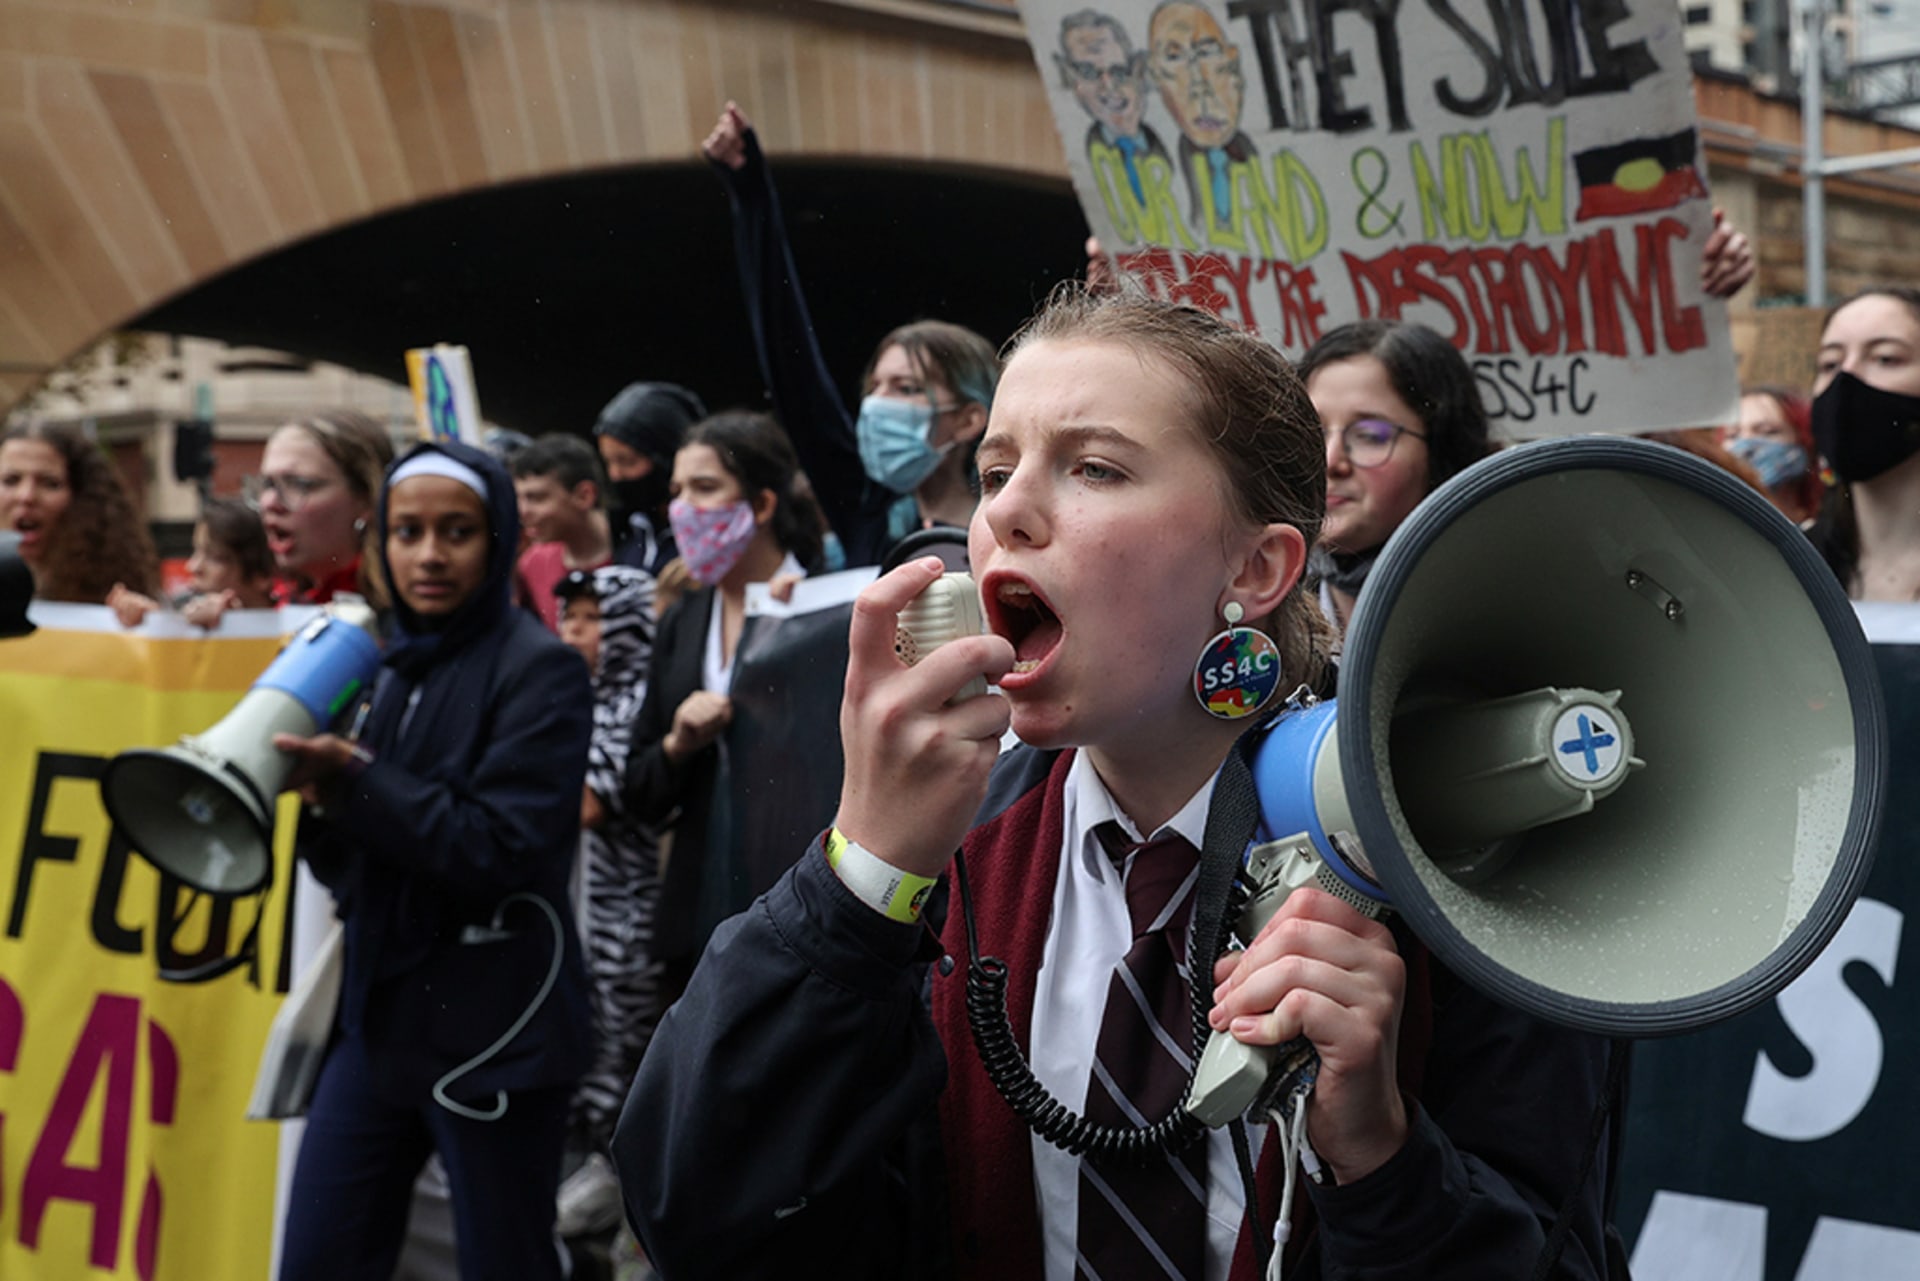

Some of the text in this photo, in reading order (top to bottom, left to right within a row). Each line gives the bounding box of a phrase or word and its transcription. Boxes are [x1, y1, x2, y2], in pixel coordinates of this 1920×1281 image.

[1227, 0, 1412, 134] THEY
[1090, 115, 1566, 265] OUR LAND & NOW
[1339, 218, 1707, 358] DESTROYING
[1472, 357, 1596, 422] SS4C
[1204, 649, 1270, 690] SS4C
